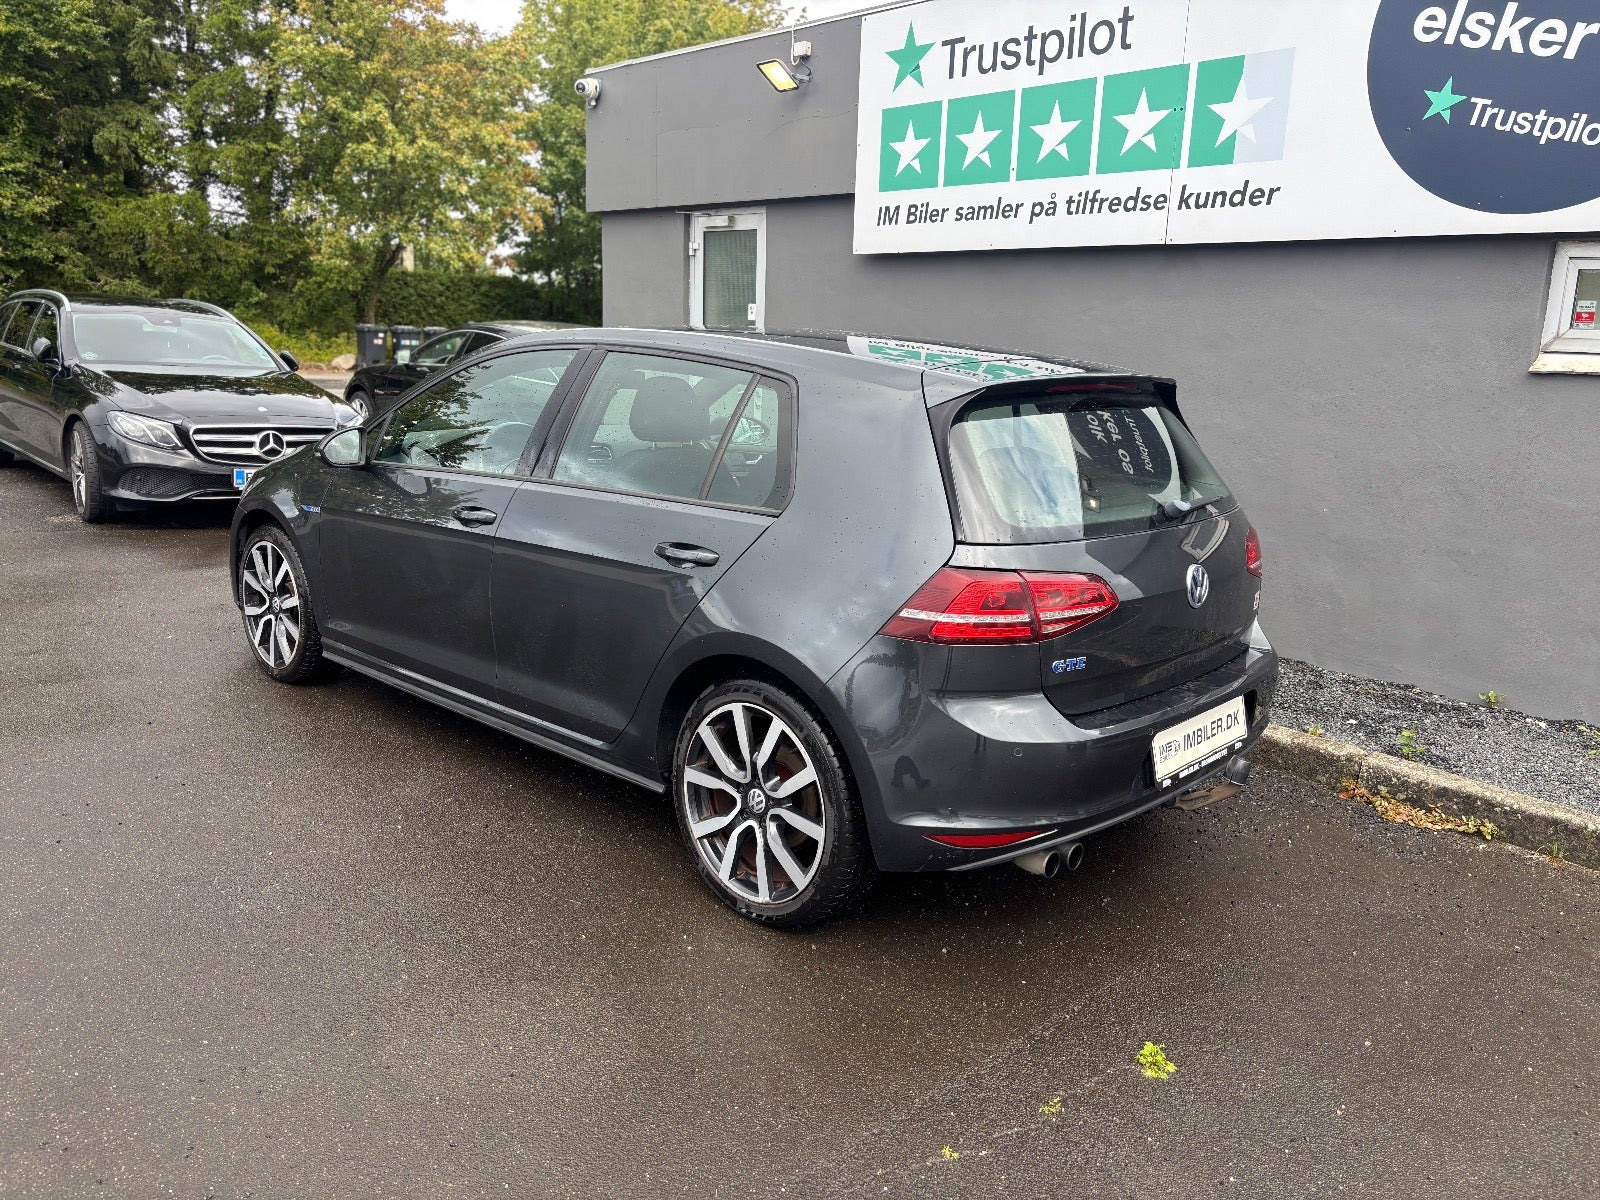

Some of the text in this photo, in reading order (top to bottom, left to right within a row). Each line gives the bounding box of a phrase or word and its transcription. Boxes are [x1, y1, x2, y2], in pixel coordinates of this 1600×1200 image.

[942, 5, 1135, 80] Trustpilot
[1413, 0, 1600, 59] elsker
[876, 180, 1280, 226] IM Biler samler på tilfredse kunder
[1052, 656, 1087, 674] GTE
[1183, 709, 1240, 752] IMBILER.DK
